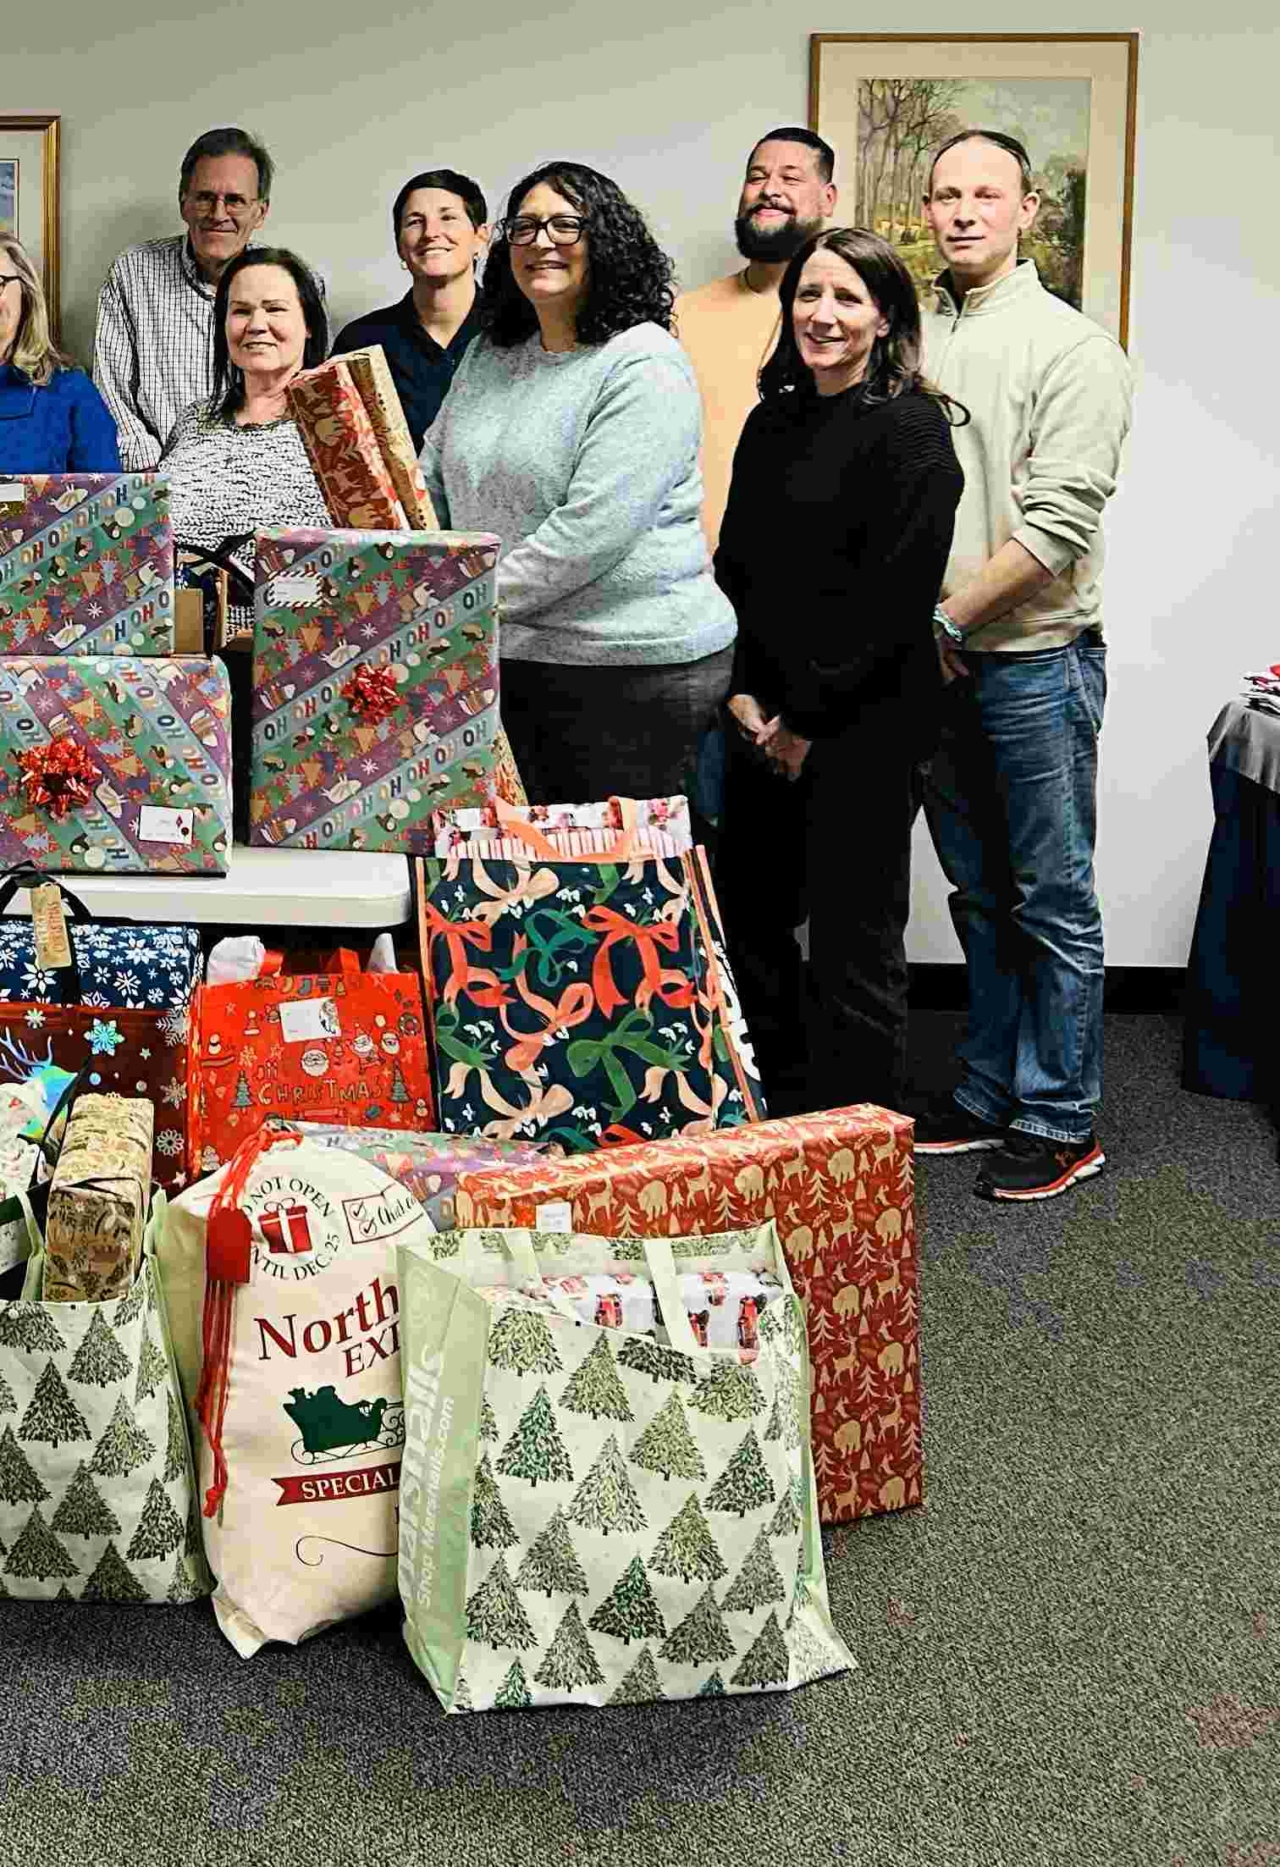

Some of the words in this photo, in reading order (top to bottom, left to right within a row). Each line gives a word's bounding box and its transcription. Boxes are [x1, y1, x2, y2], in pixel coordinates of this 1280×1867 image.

[258, 1076, 383, 1106] CHRISTMAS
[250, 1176, 282, 1205] NOT
[289, 1178, 334, 1218] OPEN
[251, 1245, 289, 1280] NTIL
[324, 1233, 341, 1252] 25
[254, 1277, 400, 1360] North
[301, 1470, 400, 1500] SPECIAL
[419, 1396, 455, 1550] Marshalls.com
[417, 1554, 434, 1606] Shop
